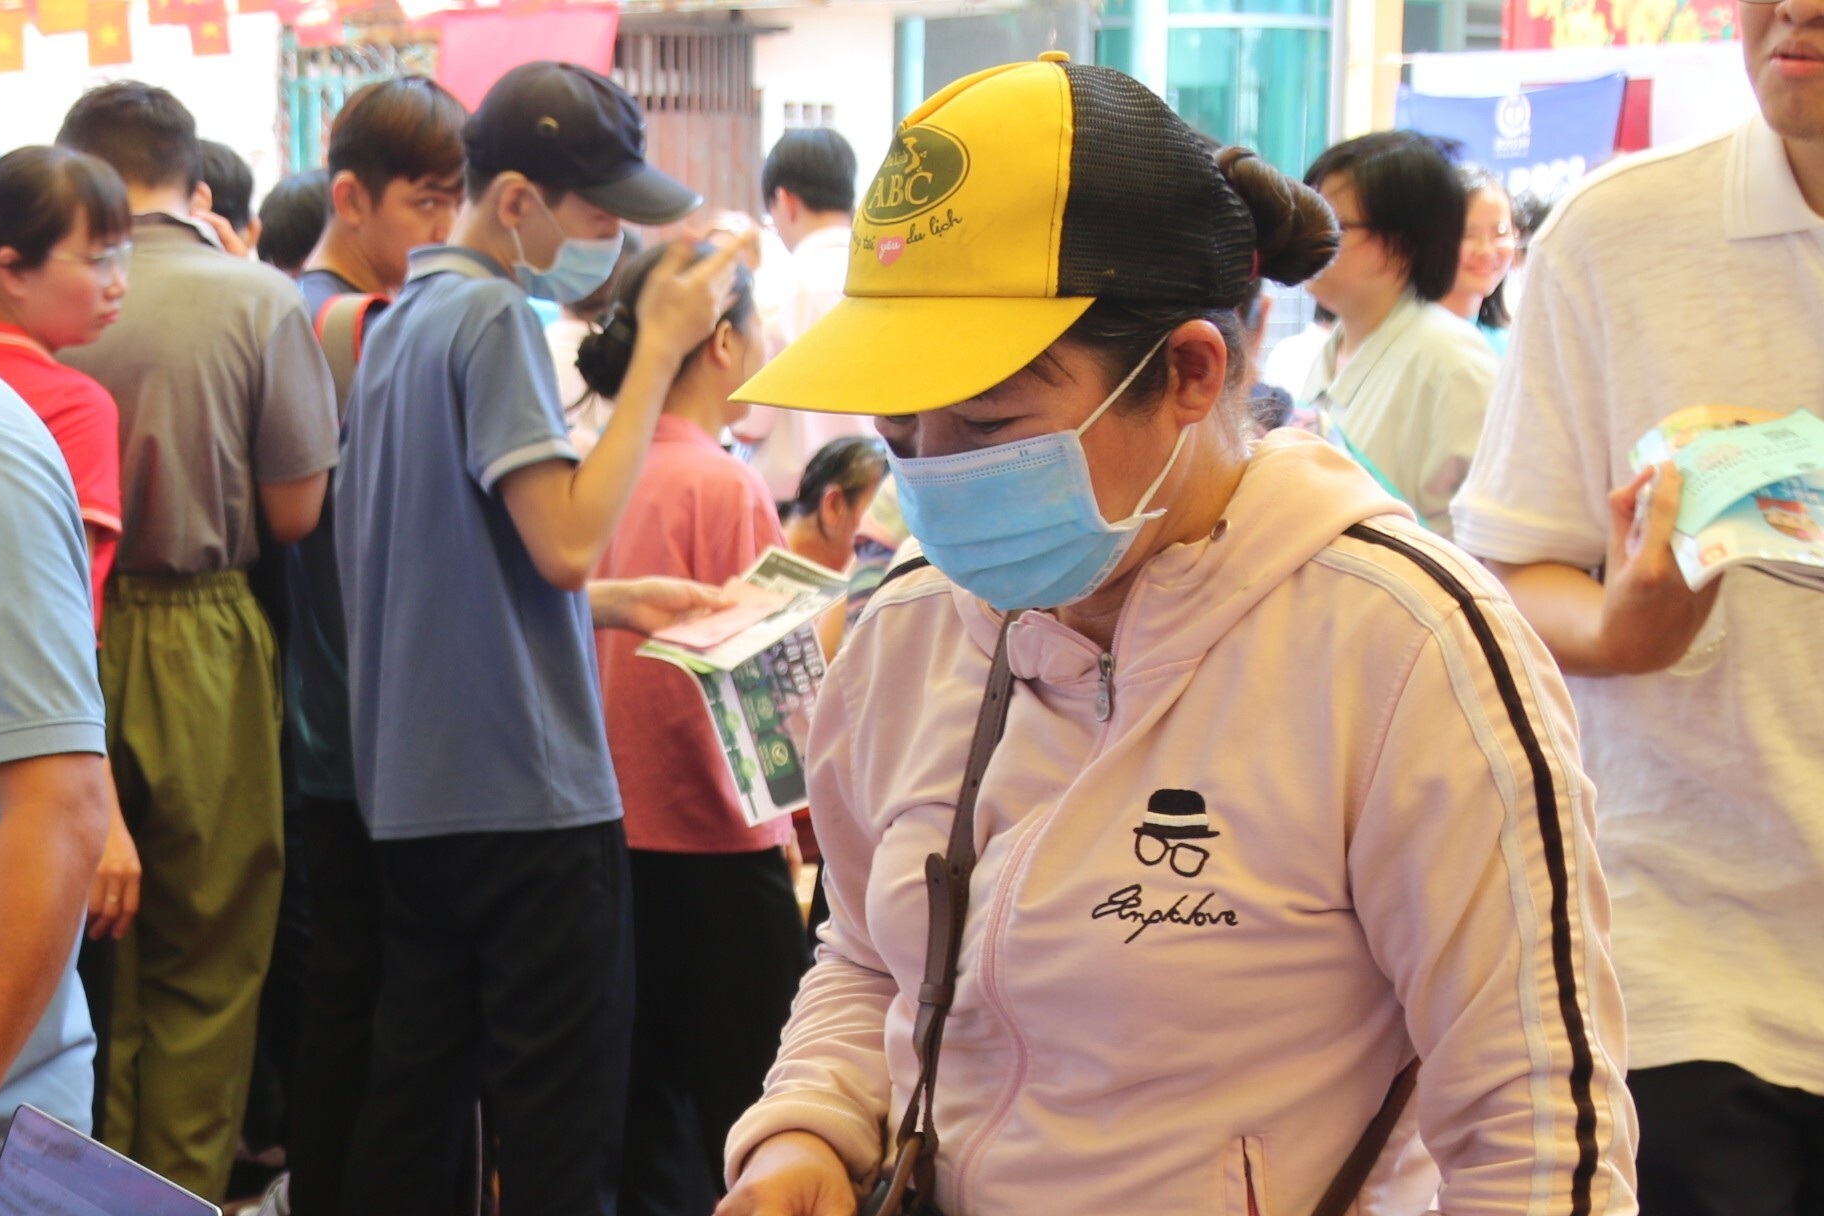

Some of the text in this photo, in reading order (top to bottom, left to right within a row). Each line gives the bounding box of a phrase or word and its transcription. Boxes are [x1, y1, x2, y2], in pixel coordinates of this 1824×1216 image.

[868, 171, 933, 210] ABC
[906, 223, 926, 244] du
[930, 209, 963, 238] lịch
